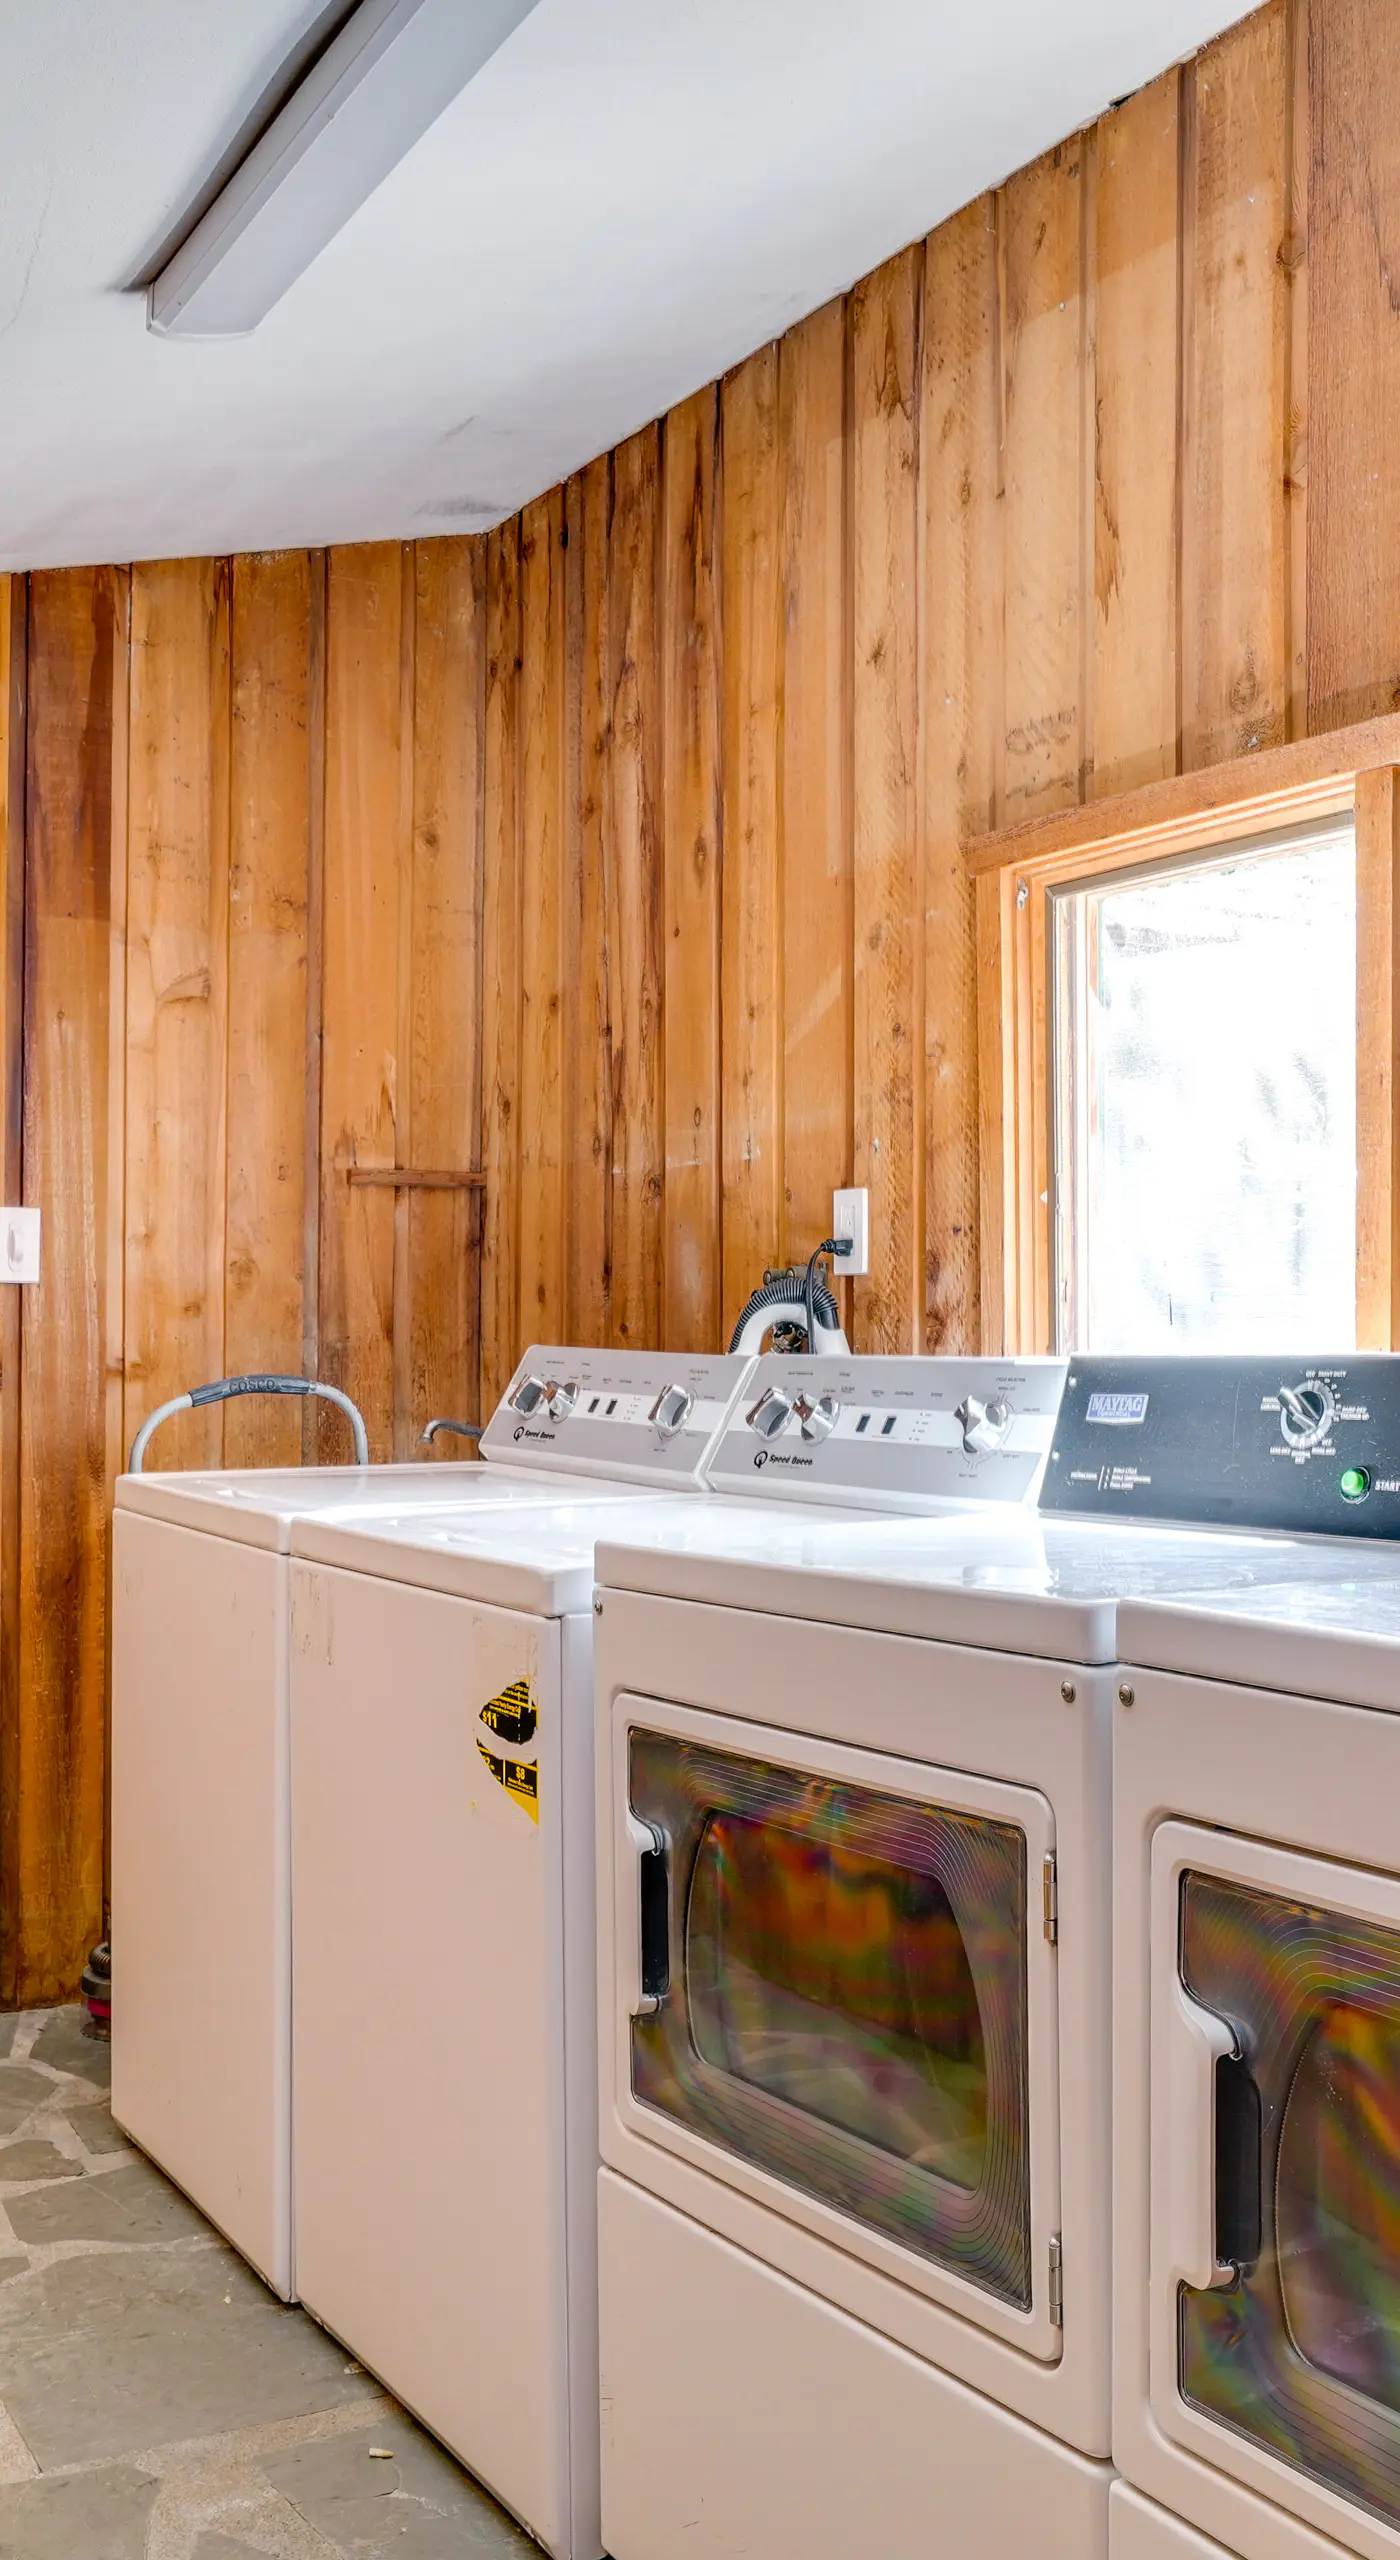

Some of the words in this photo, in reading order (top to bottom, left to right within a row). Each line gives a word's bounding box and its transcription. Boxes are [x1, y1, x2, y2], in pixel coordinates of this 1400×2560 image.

[229, 1379, 276, 1393] COSCO
[1091, 1395, 1143, 1412] MAYTAG
[524, 1429, 540, 1438] Speed
[769, 1454, 791, 1464] Speed
[791, 1456, 813, 1466] Queen
[482, 1710, 497, 1729] $11
[515, 1766, 526, 1780] $8
